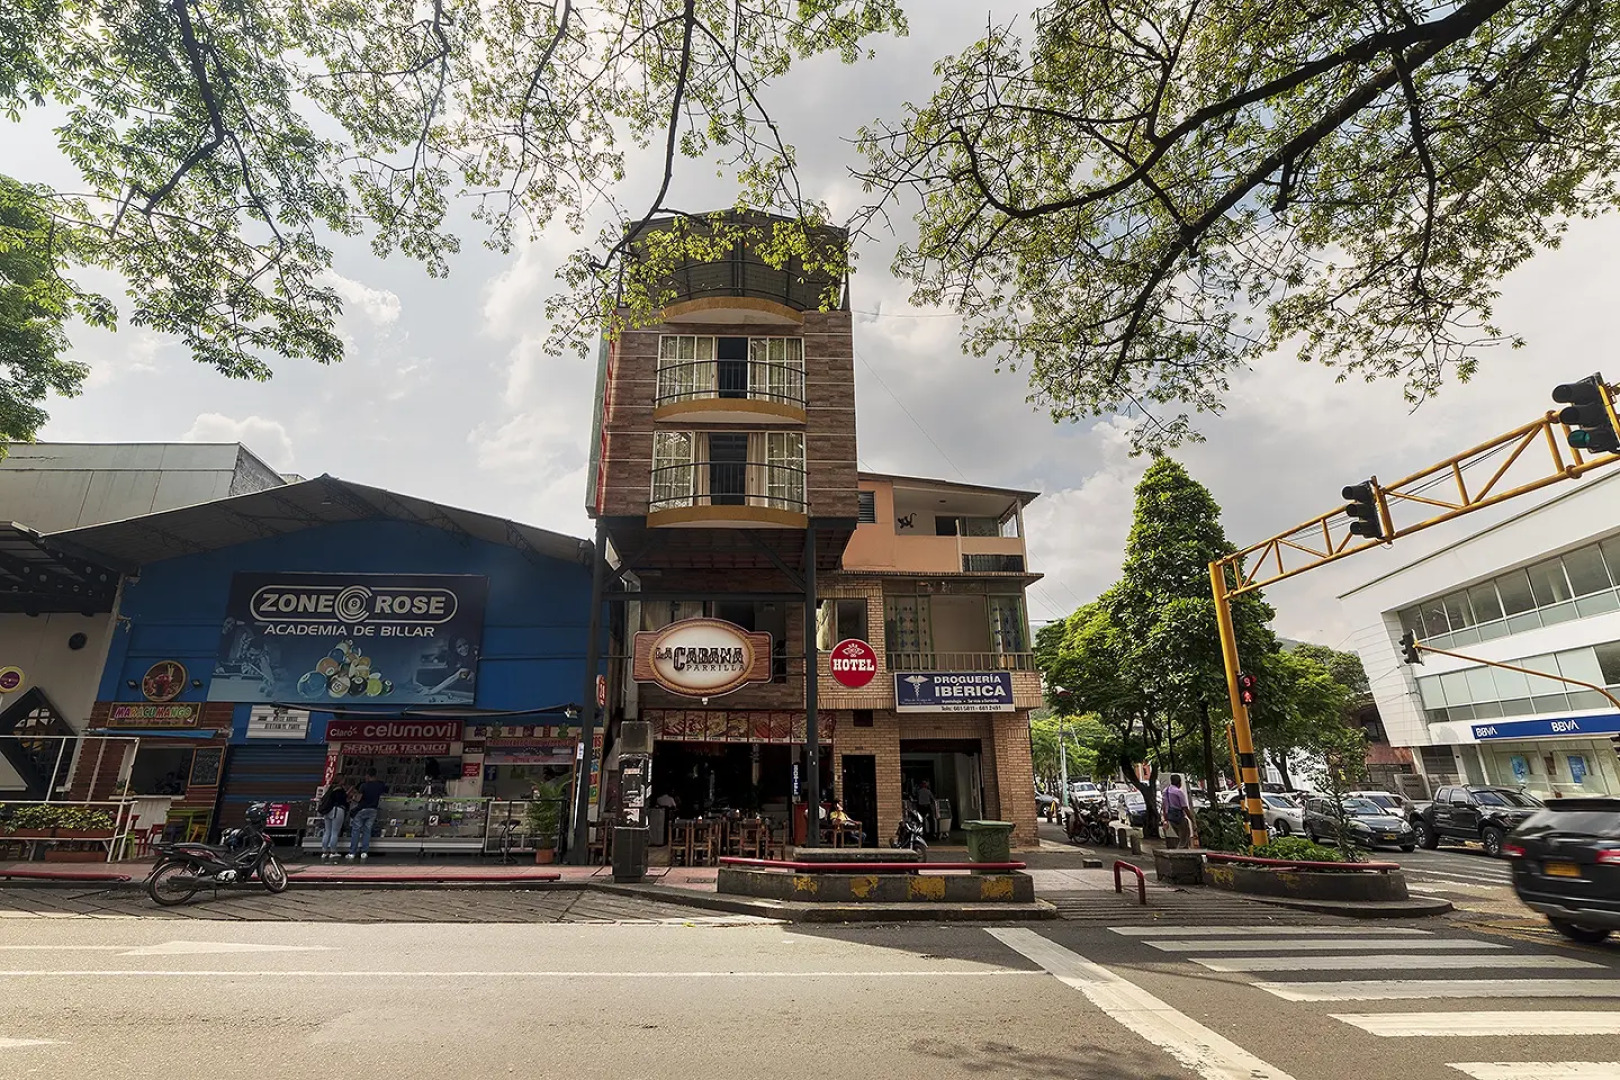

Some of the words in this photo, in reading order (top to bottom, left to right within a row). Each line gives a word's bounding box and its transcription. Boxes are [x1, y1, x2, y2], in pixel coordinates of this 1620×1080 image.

[259, 594, 335, 613] ZONE
[374, 596, 445, 614] ROSE
[264, 623, 348, 636] ACADEMIA
[353, 625, 375, 637] DE
[380, 626, 435, 637] BILLAR
[655, 647, 673, 660] LA
[686, 664, 745, 672] PARRILLA
[833, 658, 875, 671] HOTEL
[934, 674, 1002, 684] DROGUERÍA
[935, 683, 1007, 697] IBÉRICA
[330, 726, 354, 737] Claro
[363, 722, 458, 738] celumovil
[1475, 726, 1498, 737] BBVA
[1551, 720, 1580, 732] BBVA
[343, 743, 398, 751] SERVICIO
[399, 743, 448, 751] TECNICO
